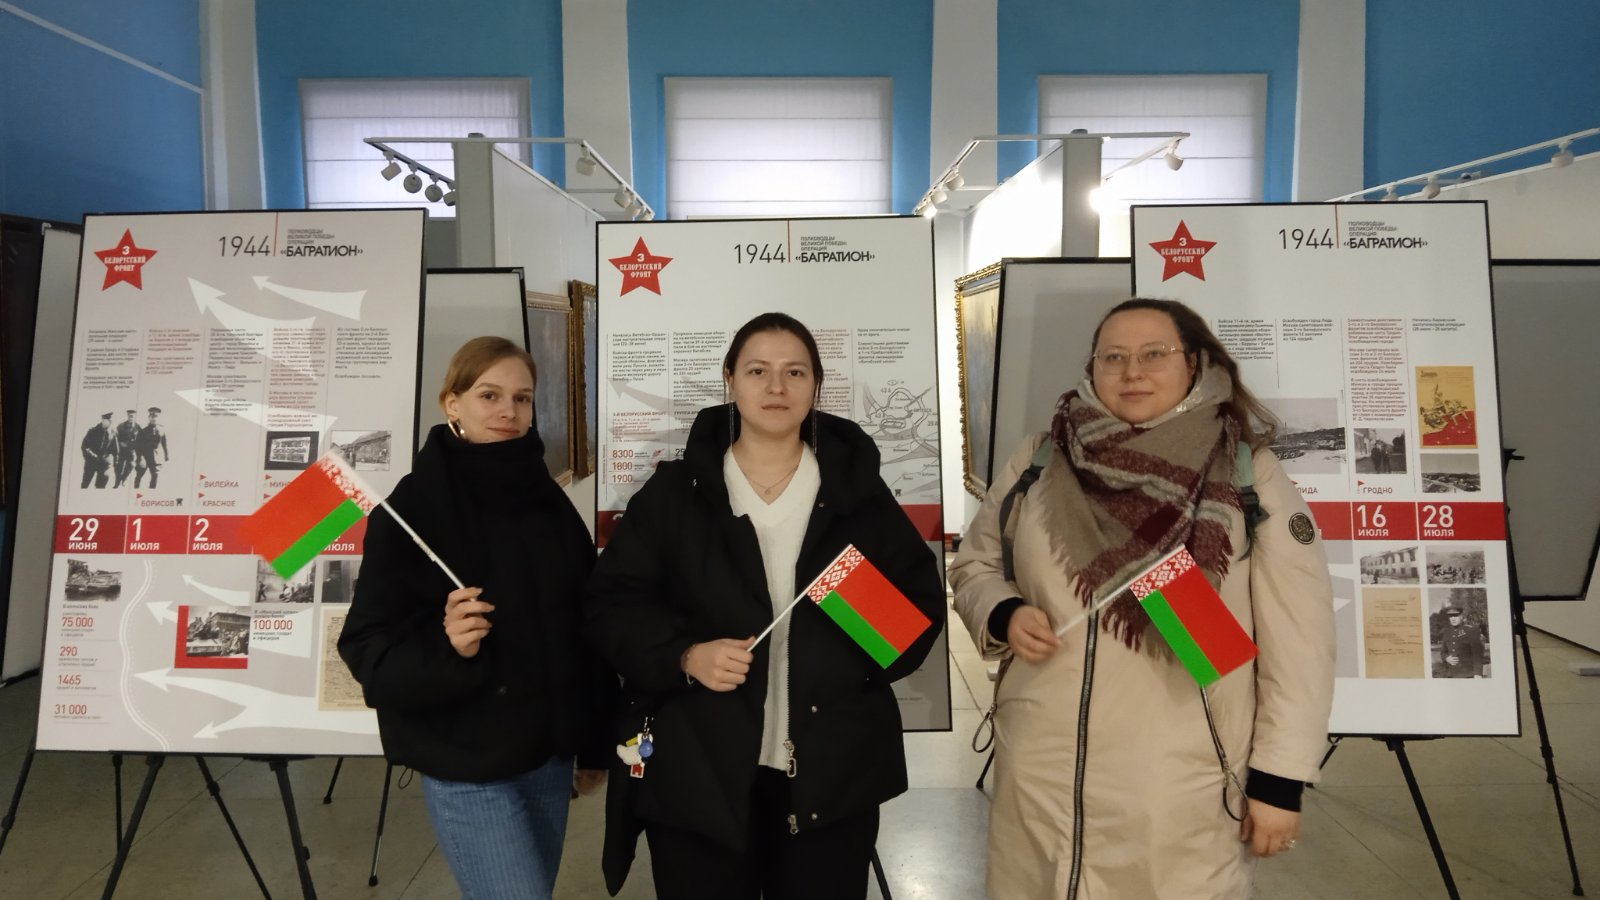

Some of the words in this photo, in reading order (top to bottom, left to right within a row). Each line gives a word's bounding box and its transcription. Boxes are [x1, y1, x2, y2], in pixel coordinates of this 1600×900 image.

[1179, 237, 1187, 246] 3
[1279, 228, 1334, 250] 1944
[1343, 237, 1428, 249] «БАГРАТИОН»
[122, 245, 130, 256] 3
[218, 235, 271, 257] 1944
[280, 245, 363, 257] «БАГРАТИОН»
[1160, 246, 1205, 256] БЕЛОРУССКИЙ
[637, 253, 645, 263] 3
[734, 244, 786, 264] 1944
[795, 251, 875, 263] «БАГРАТИОН»
[104, 255, 147, 265] БЕЛОРУССКИЙ
[1172, 255, 1195, 264] ФРОНТ
[114, 264, 135, 272] ФРОНТ
[619, 262, 662, 271] БЕЛОРУССКИЙ
[630, 270, 652, 278] ФРОНТ
[612, 449, 634, 458] 8300
[612, 462, 633, 470] 1800
[612, 474, 633, 483] 1900
[203, 480, 240, 488] ВИЛЕЙКА
[1363, 487, 1393, 495] ГРОДНО
[140, 499, 175, 507] БОРИСОВ
[202, 500, 236, 508] КРАСНОЕ
[1356, 505, 1387, 528] 16
[1423, 505, 1454, 528] 28
[69, 518, 99, 542] 29
[130, 518, 142, 541] 1
[194, 518, 210, 542] 2
[1358, 529, 1389, 537] ИЮЛЯ
[1424, 529, 1454, 537] ИЮЛЯ
[68, 541, 98, 551] ИЮНЯ
[130, 541, 160, 551] ИЮЛЯ
[192, 541, 223, 551] ИЮЛЯ
[62, 617, 74, 628] 75
[75, 617, 94, 628] 000
[253, 619, 272, 630] 100
[274, 619, 293, 630] 000
[60, 646, 78, 657] 290
[58, 674, 81, 685] 1465
[54, 704, 66, 715] 31
[69, 704, 87, 715] 000
